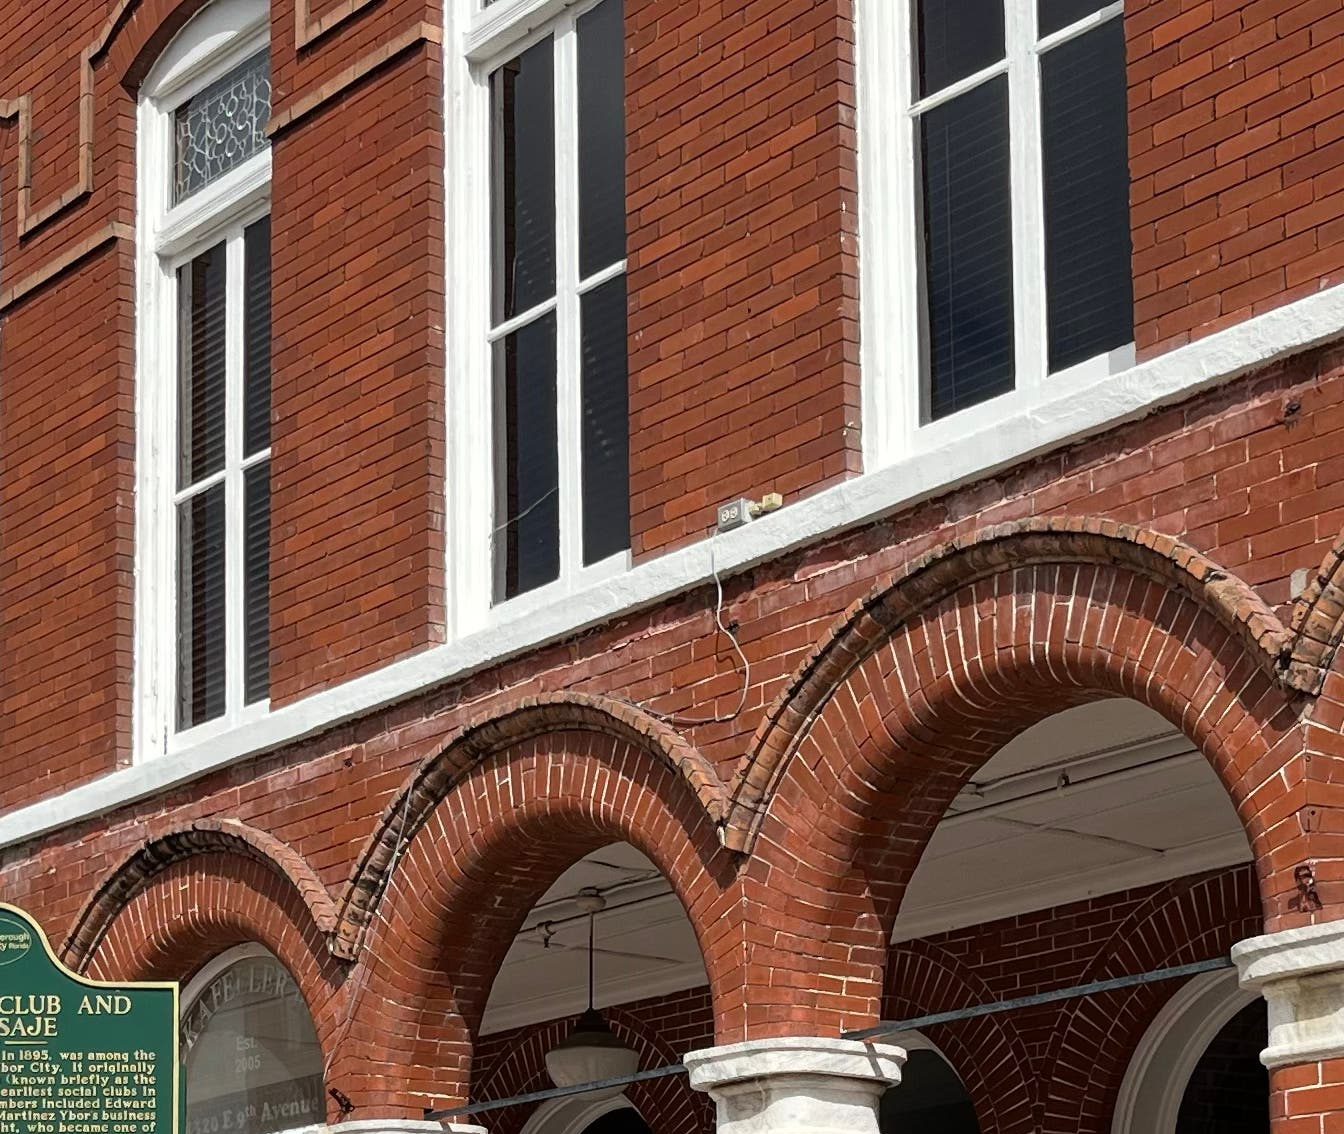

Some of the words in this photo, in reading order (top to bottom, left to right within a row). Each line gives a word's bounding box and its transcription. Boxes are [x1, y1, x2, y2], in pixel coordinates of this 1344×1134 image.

[77, 994, 132, 1015] AND
[1, 1050, 15, 1060] in
[19, 1050, 52, 1061] 1895,
[59, 1052, 83, 1060] was
[87, 1051, 129, 1061] among
[133, 1049, 156, 1059] the
[29, 1063, 63, 1075] City.
[72, 1063, 83, 1073] It
[88, 1062, 156, 1074] originally
[5, 1075, 56, 1086] (known
[60, 1074, 110, 1086] briefly
[114, 1076, 129, 1084] as
[133, 1074, 157, 1084] the
[0, 1087, 53, 1097] earliest
[57, 1087, 97, 1097] social
[102, 1086, 138, 1096] clubs
[142, 1086, 156, 1096] in
[42, 1099, 101, 1109] included
[105, 1098, 157, 1108] Edward
[59, 1111, 99, 1121] Ybor's
[101, 1110, 156, 1120] business
[222, 1109, 233, 1129] E
[261, 1096, 319, 1122] Avenue
[26, 1123, 54, 1133] who
[58, 1122, 109, 1132] became
[113, 1124, 138, 1132] one
[141, 1122, 155, 1132] of
